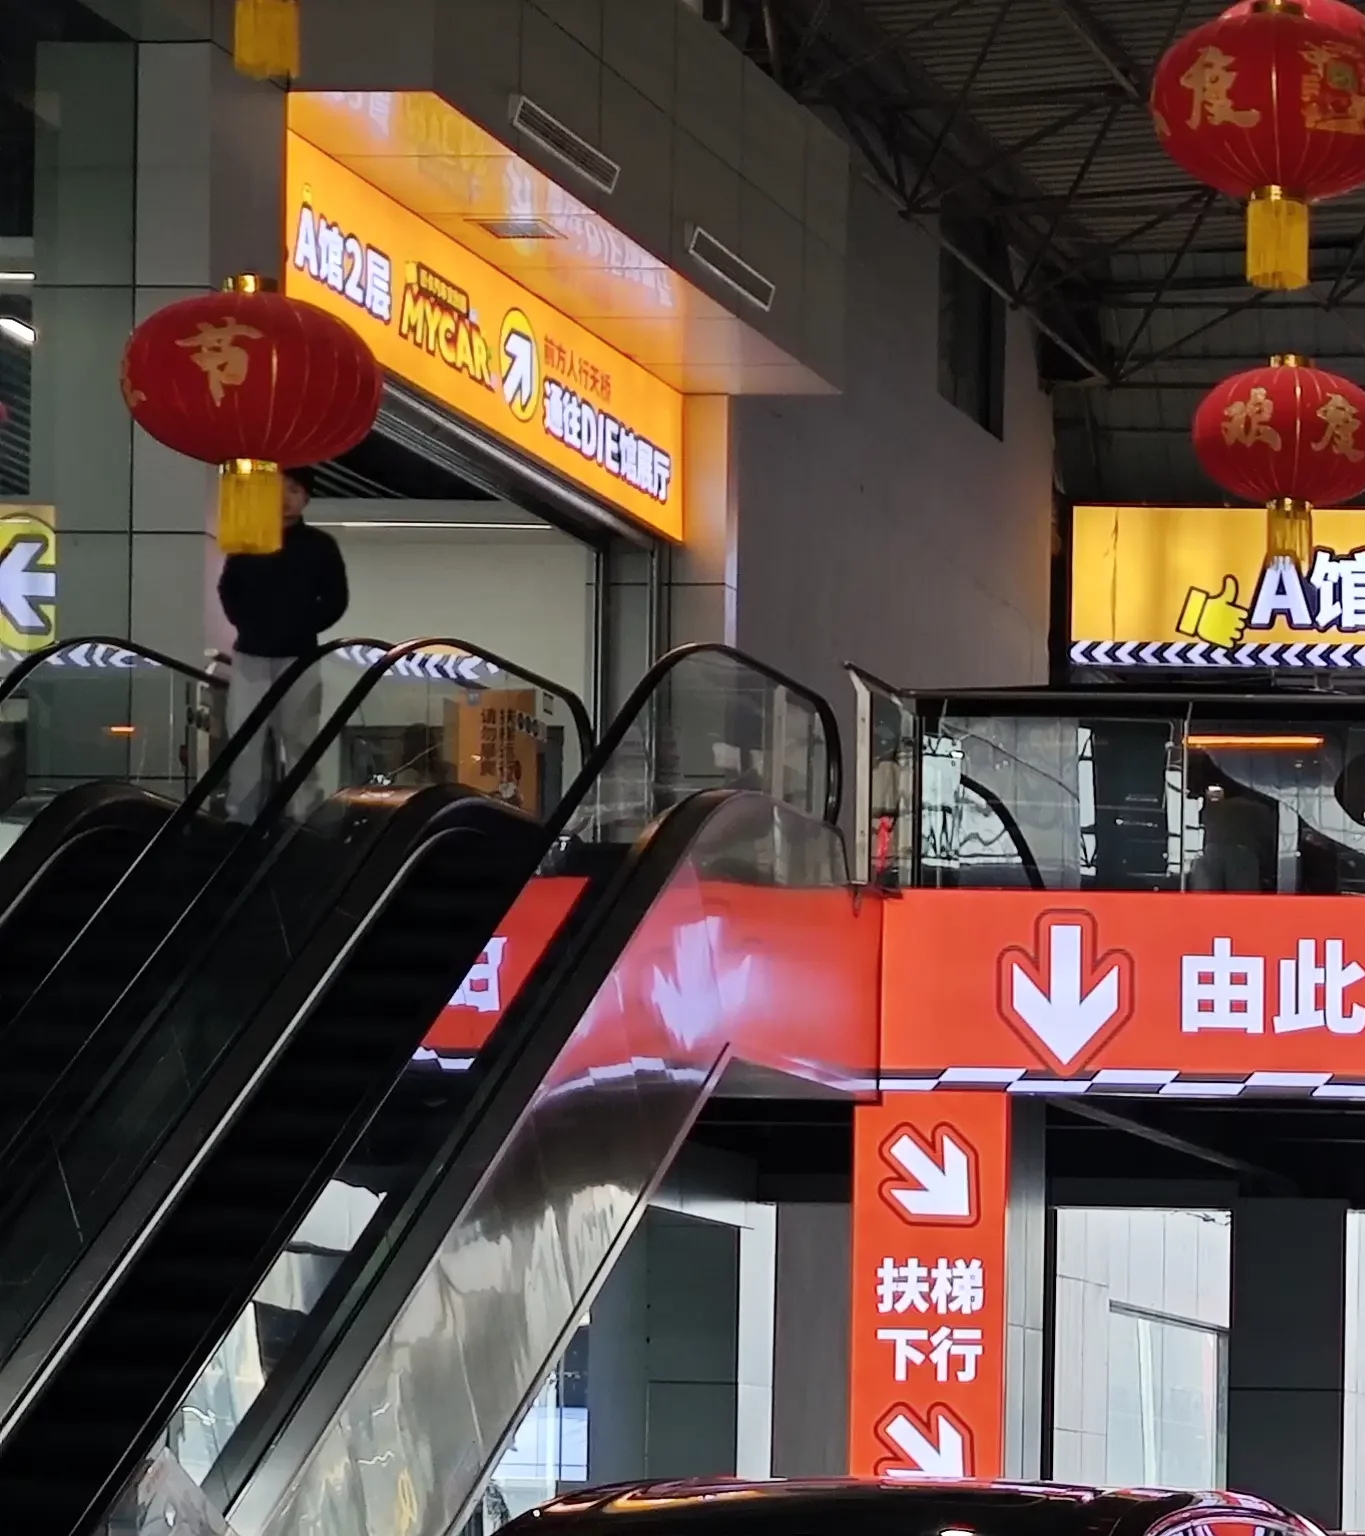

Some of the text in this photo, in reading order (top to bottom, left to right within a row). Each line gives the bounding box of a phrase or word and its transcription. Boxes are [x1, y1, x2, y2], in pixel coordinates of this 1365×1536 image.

[294, 203, 392, 324] A馆2层
[400, 284, 496, 393] MYCAR
[876, 1256, 986, 1316] 扶梯
[875, 1325, 985, 1384] 下行
